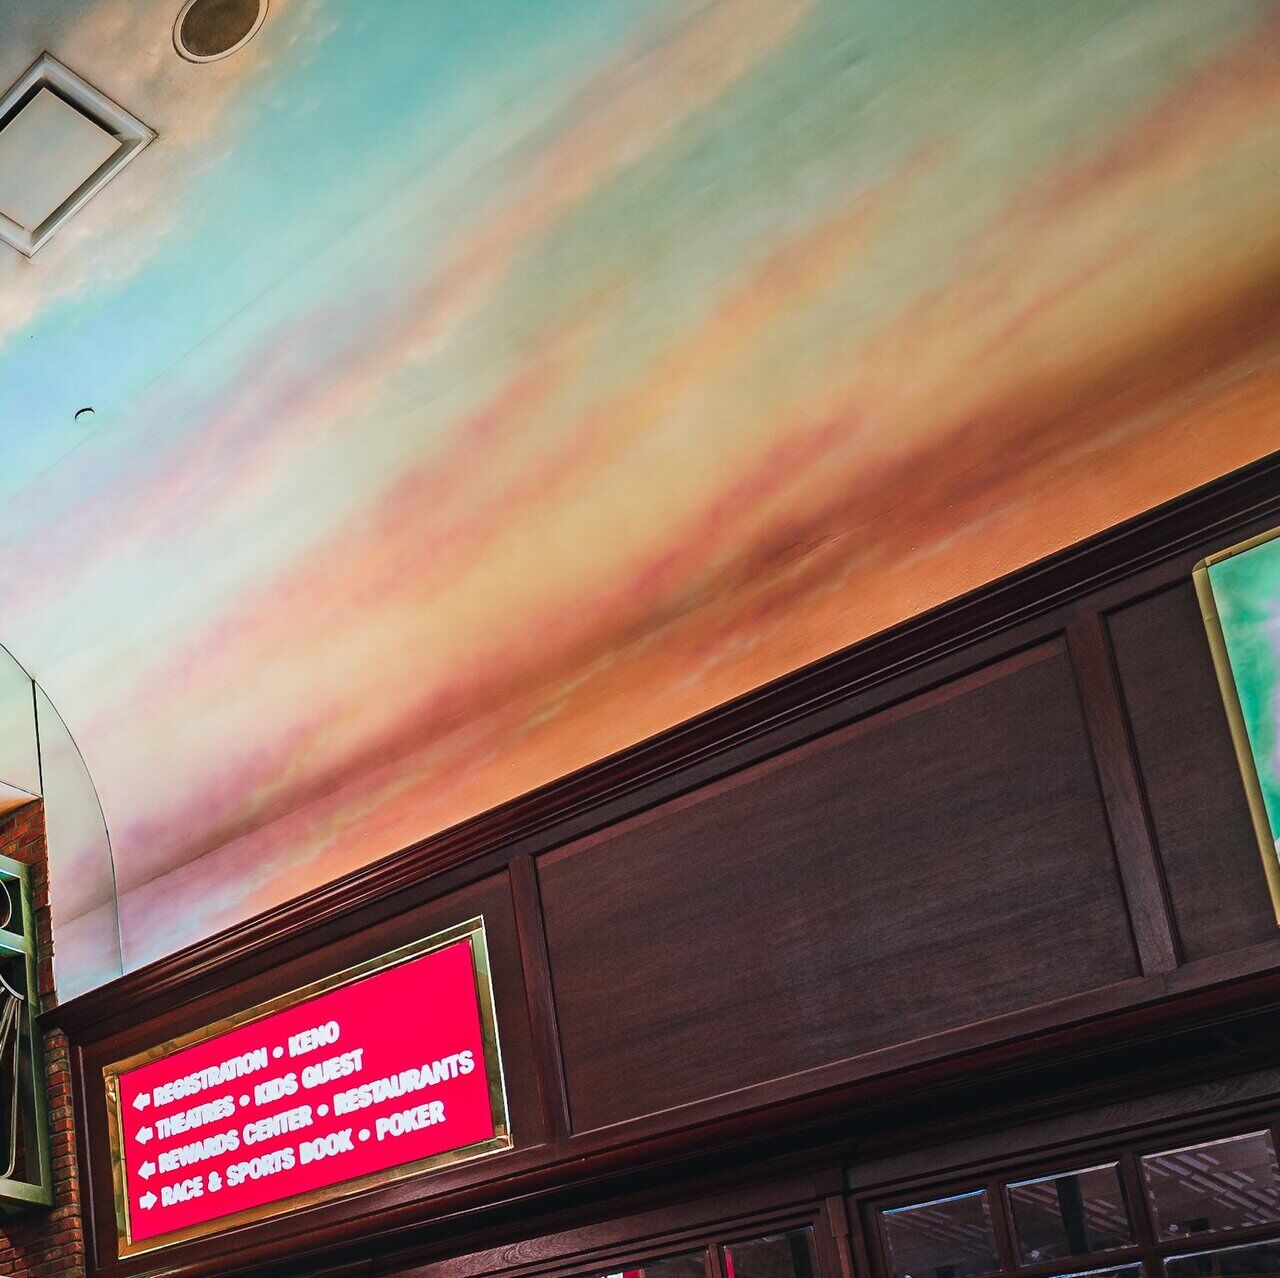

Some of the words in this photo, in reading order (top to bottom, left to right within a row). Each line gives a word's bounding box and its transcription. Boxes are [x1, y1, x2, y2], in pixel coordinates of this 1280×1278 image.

[153, 1047, 268, 1107] REGISTRATION
[288, 1020, 340, 1058] KENO
[155, 1095, 236, 1140] THEATRES
[254, 1072, 299, 1106] KIDS
[301, 1048, 364, 1089] QUEST
[158, 1129, 240, 1174] REWARDS
[243, 1105, 313, 1146] CENTER
[333, 1050, 475, 1116] RESTAURANTS
[161, 1175, 204, 1207] RACE
[208, 1171, 223, 1192] &
[226, 1147, 296, 1187] SPORTS
[299, 1128, 355, 1165] BOOK
[375, 1100, 446, 1142] POKER
